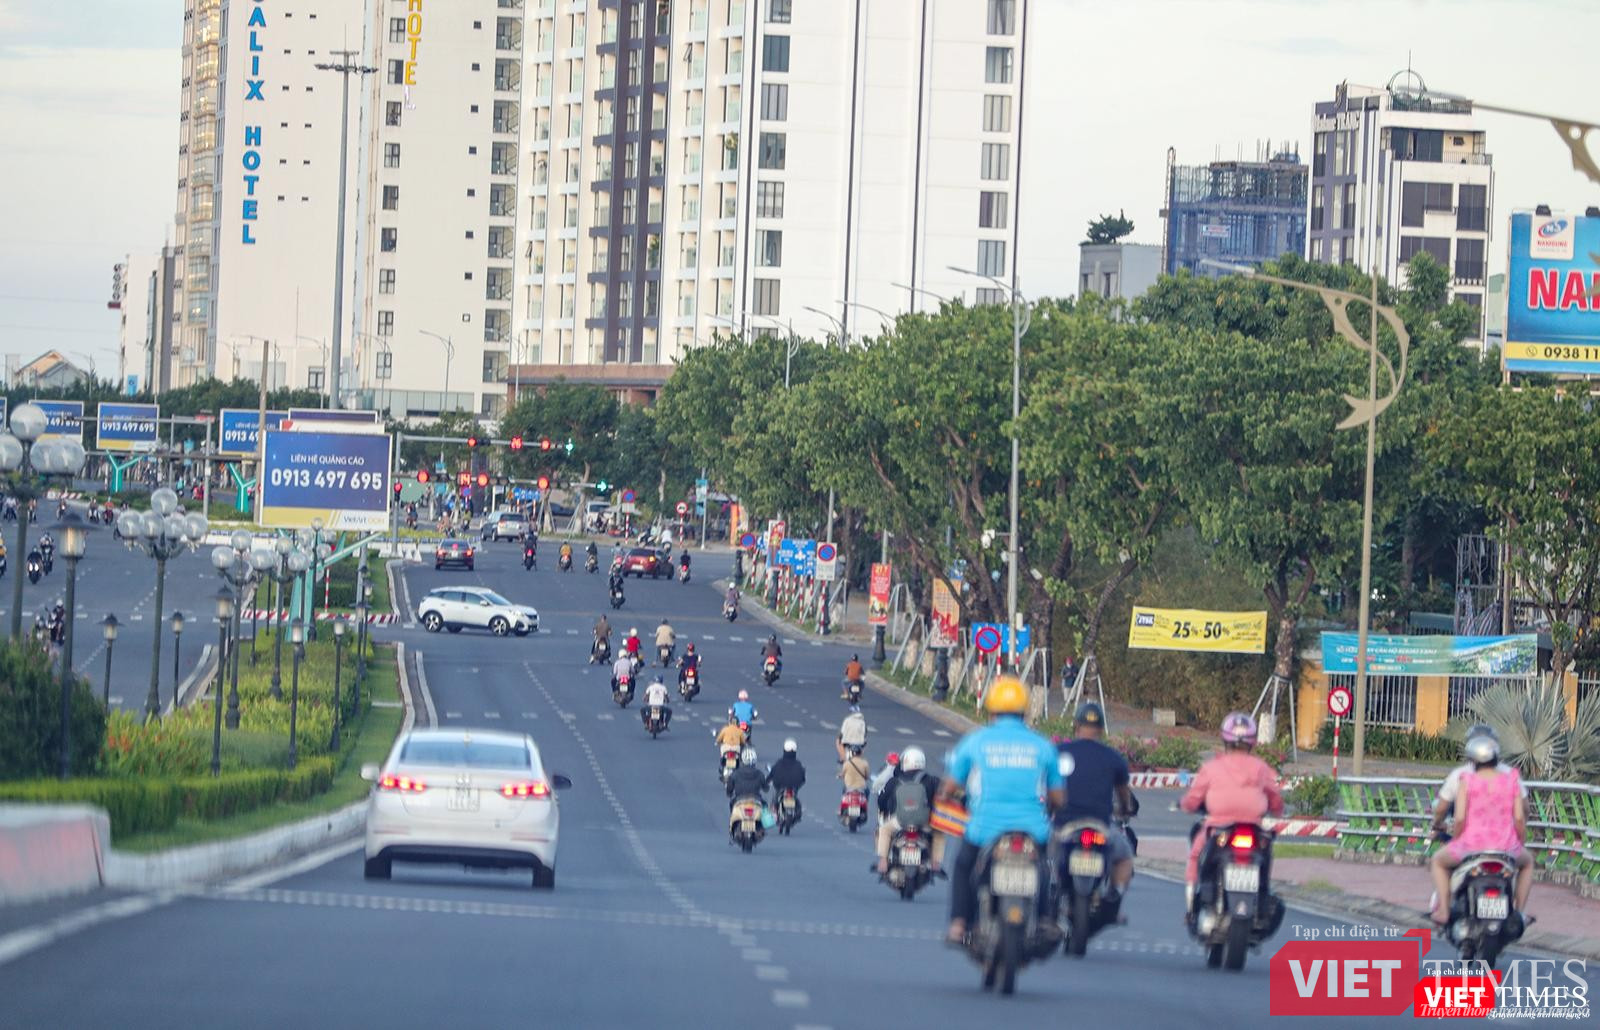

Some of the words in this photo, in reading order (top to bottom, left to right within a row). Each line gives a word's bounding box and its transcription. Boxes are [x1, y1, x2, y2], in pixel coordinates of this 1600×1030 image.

[245, 0, 267, 101] ALIX
[242, 126, 262, 244] HOTEL
[1528, 267, 1600, 311] NA
[1544, 346, 1580, 359] 0938
[102, 422, 122, 432] 0913
[122, 423, 138, 433] 497
[225, 430, 246, 442] 0913
[291, 453, 306, 463] LIÊN
[307, 454, 317, 465] HỆ
[319, 454, 346, 465] QUẢNG
[348, 456, 364, 466] CÁO
[271, 468, 310, 487] 0913
[314, 470, 347, 489] 497
[350, 471, 382, 490] 695
